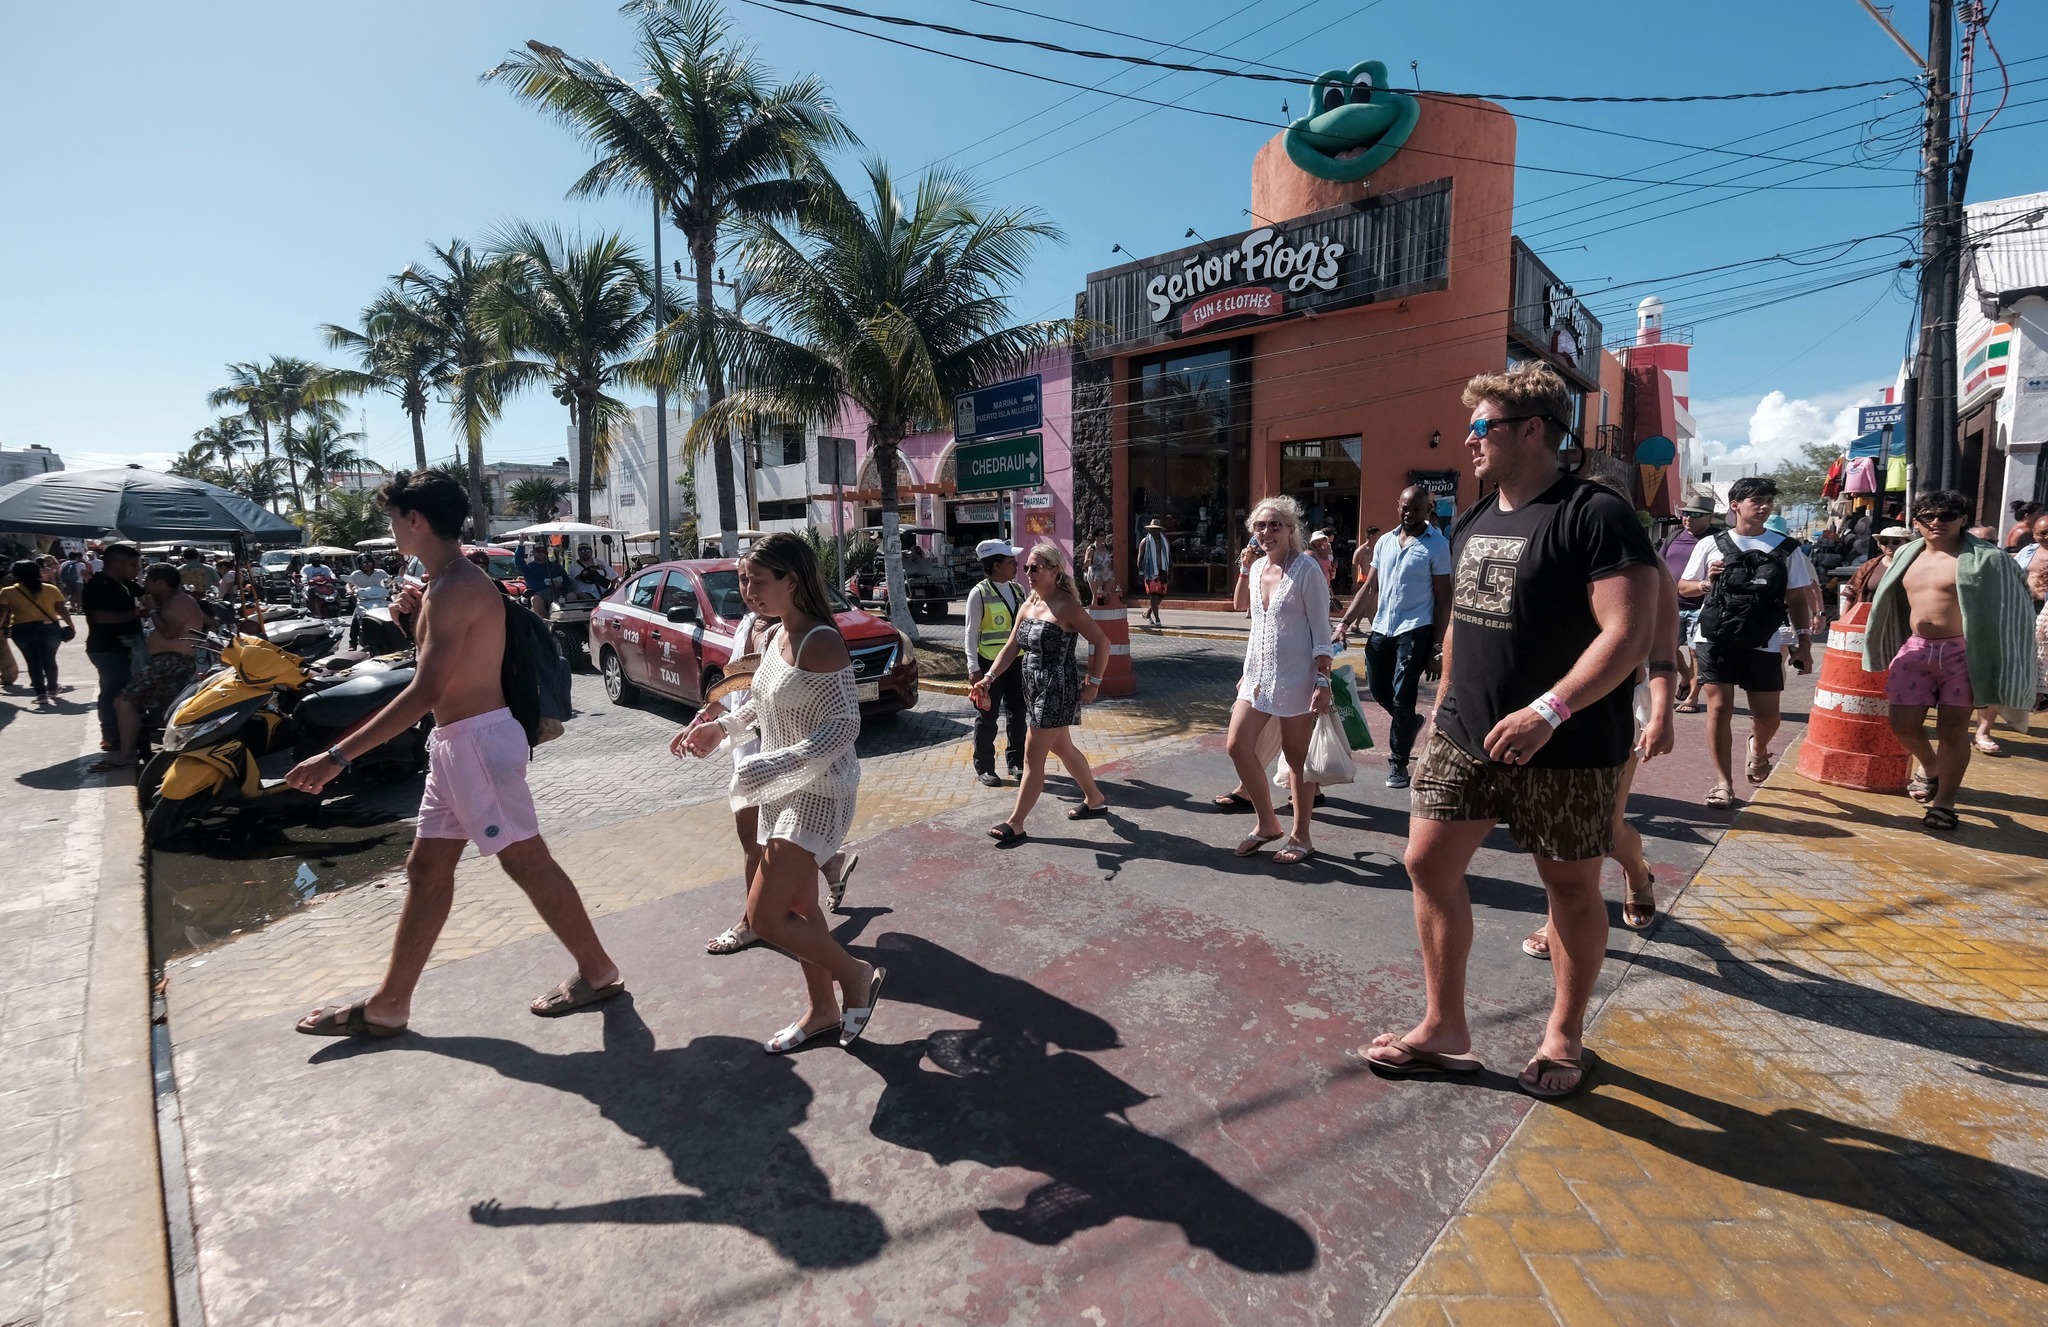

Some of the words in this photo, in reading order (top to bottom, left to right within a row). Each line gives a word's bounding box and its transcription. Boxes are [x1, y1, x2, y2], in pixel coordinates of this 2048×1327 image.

[1146, 249, 1240, 323] Señor
[1240, 228, 1345, 292] Frog's
[1193, 302, 1214, 322] FUN
[1224, 294, 1272, 311] CLOTHES
[993, 398, 1018, 409] MARINA
[976, 412, 998, 422] PUERTO
[998, 410, 1011, 418] ISLA
[1011, 404, 1037, 416] MUJERES
[1864, 414, 1902, 424] MAYAN
[972, 453, 1025, 476] CHEDRAUI
[1024, 496, 1048, 505] PHARMACY
[965, 505, 998, 514] PHARMACY
[969, 513, 995, 521] FARMACIA
[1454, 611, 1483, 625] ROGERS
[1485, 619, 1512, 630] GEAR
[623, 628, 640, 643] 0129
[660, 667, 680, 686] TAXI
